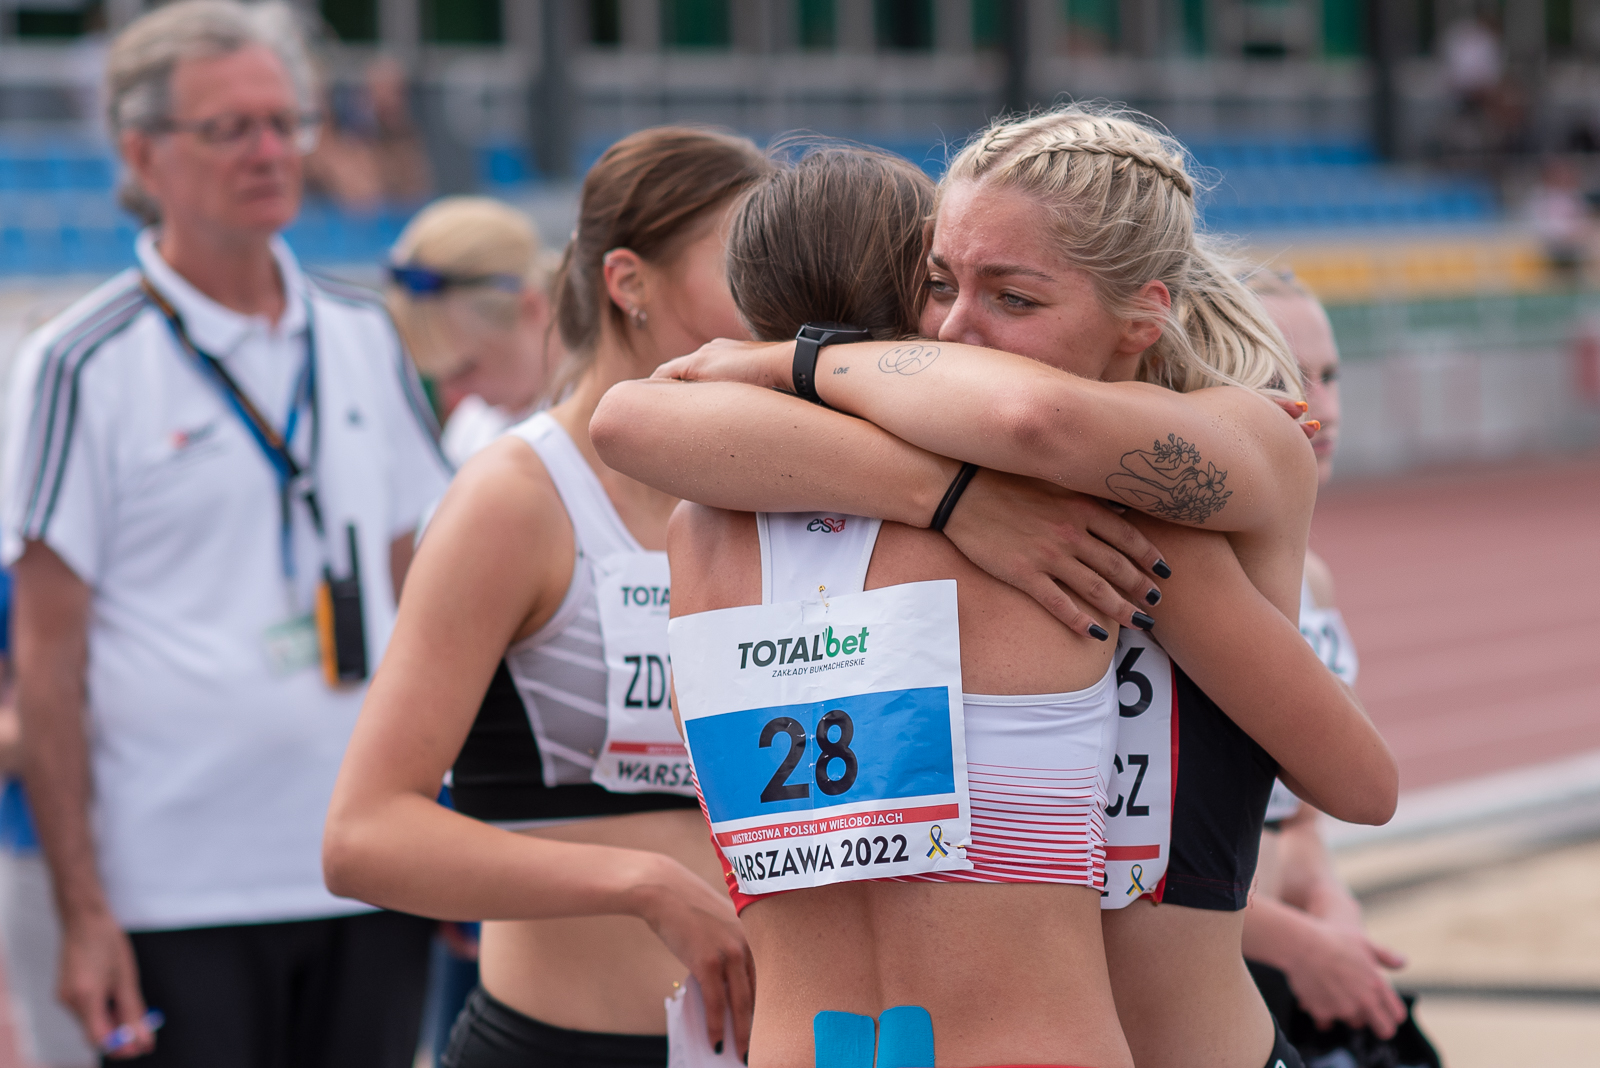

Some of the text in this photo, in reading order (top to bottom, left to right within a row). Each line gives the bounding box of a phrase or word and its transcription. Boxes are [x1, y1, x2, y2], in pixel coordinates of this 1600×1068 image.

[833, 366, 850, 375] LOVE
[738, 625, 870, 669] TOTALbet
[624, 654, 672, 709] ZD
[771, 658, 866, 678] ZAKŁADY BUKMACHERSKIE
[1115, 647, 1154, 719] 6
[758, 709, 858, 804] 28
[731, 812, 904, 844] MISTRZOSTWA POLSKI W WIELOBOJACH
[840, 834, 910, 868] 2022
